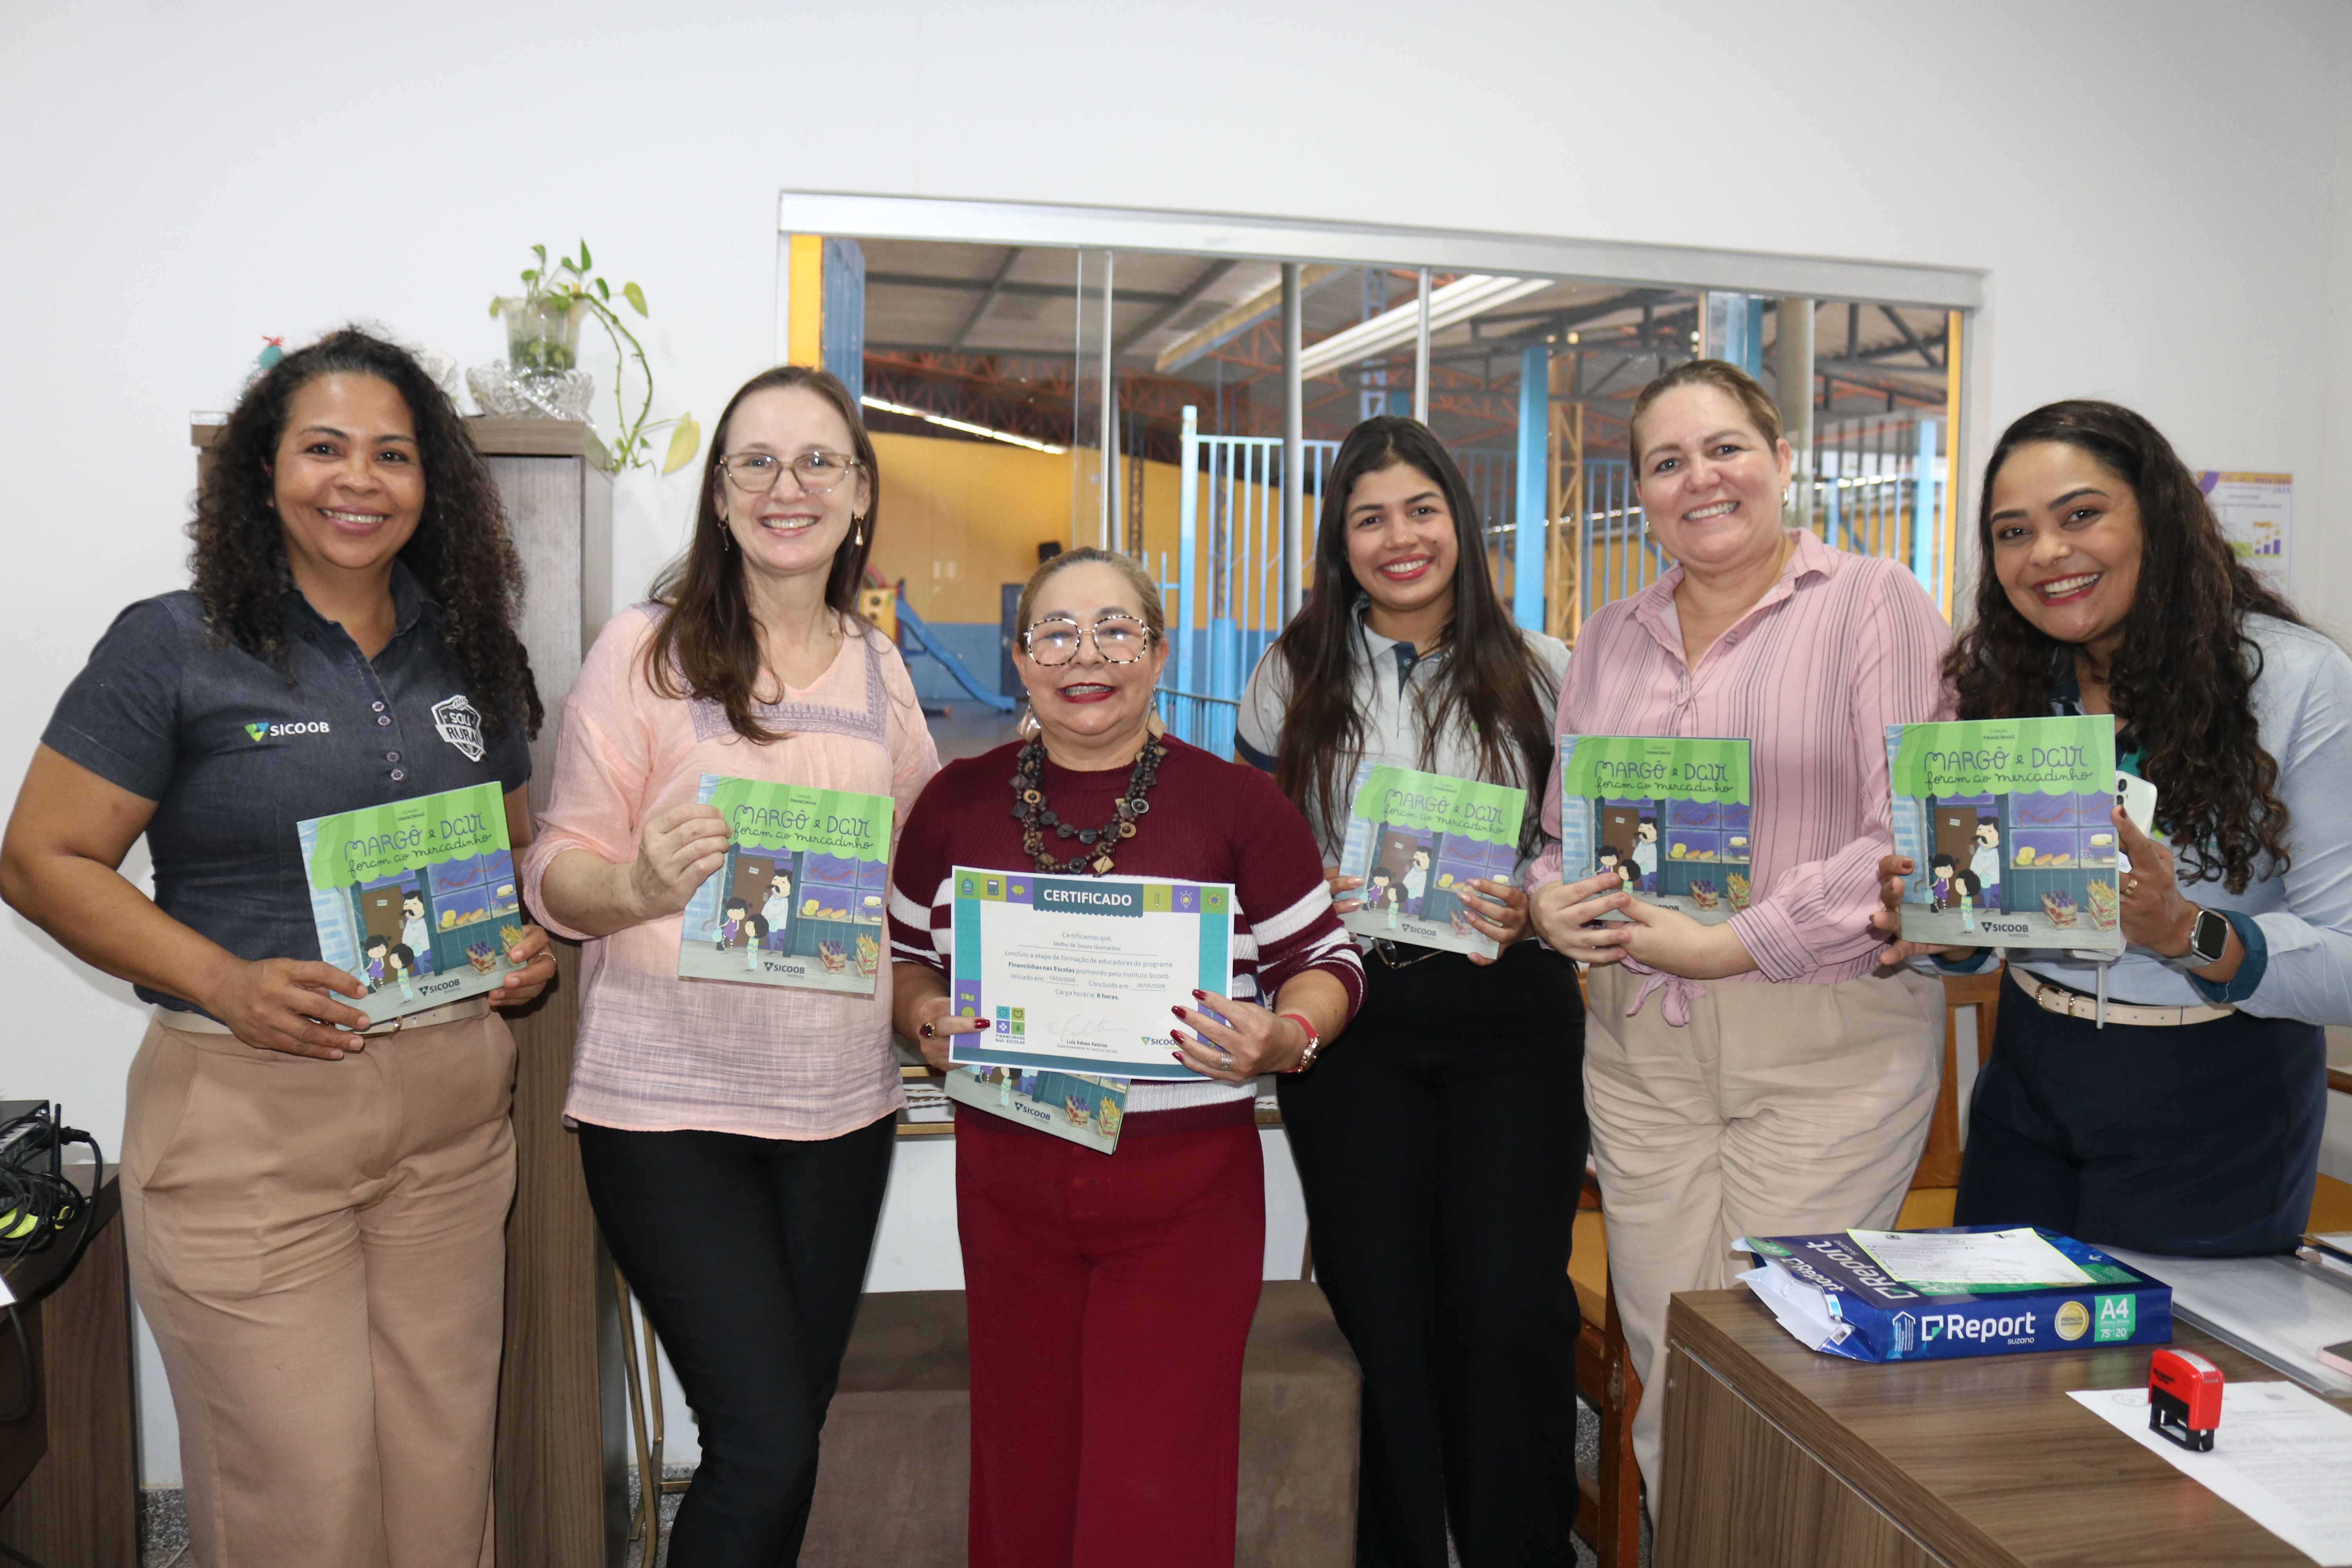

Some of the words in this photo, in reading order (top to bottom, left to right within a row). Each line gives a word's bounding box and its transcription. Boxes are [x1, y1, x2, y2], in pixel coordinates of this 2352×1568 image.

[449, 712, 471, 726] SOU
[270, 721, 330, 737] SICOOB
[1925, 746, 2010, 771] MARGÔ
[2015, 755, 2024, 764] e
[1595, 760, 1667, 779] MARGÔ
[1595, 777, 1635, 793] foram
[1655, 782, 1733, 793] mercadinho
[1925, 771, 1971, 790] foram
[1994, 768, 2093, 782] mercadinho
[1384, 789, 1450, 813] MARGÔ
[733, 805, 810, 830] MARGÔ
[813, 820, 820, 828] e
[1383, 803, 1418, 818] foram
[1436, 816, 1505, 834] mercadinho
[344, 825, 422, 861] MARGÔ
[428, 829, 436, 838] e
[733, 822, 773, 839] foram
[795, 832, 874, 849] mercadinho
[347, 858, 391, 878] foram
[394, 853, 410, 862] ao
[412, 833, 492, 858] mercadinho
[1044, 889, 1132, 906] CERTIFICADO
[1062, 932, 1099, 940] Certificamos
[1410, 927, 1437, 936] SICOOB
[1993, 924, 2028, 932] SICOOB
[774, 964, 805, 974] SICOOB
[1008, 962, 1042, 970] Financinhas
[429, 979, 460, 993] SICOOB
[1023, 1106, 1050, 1120] SICOOB
[1806, 1241, 1896, 1287] Report
[2100, 1298, 2129, 1320] A4
[1947, 1312, 2036, 1343] Report
[2100, 1328, 2111, 1338] 75
[2007, 1337, 2034, 1345] suzano
